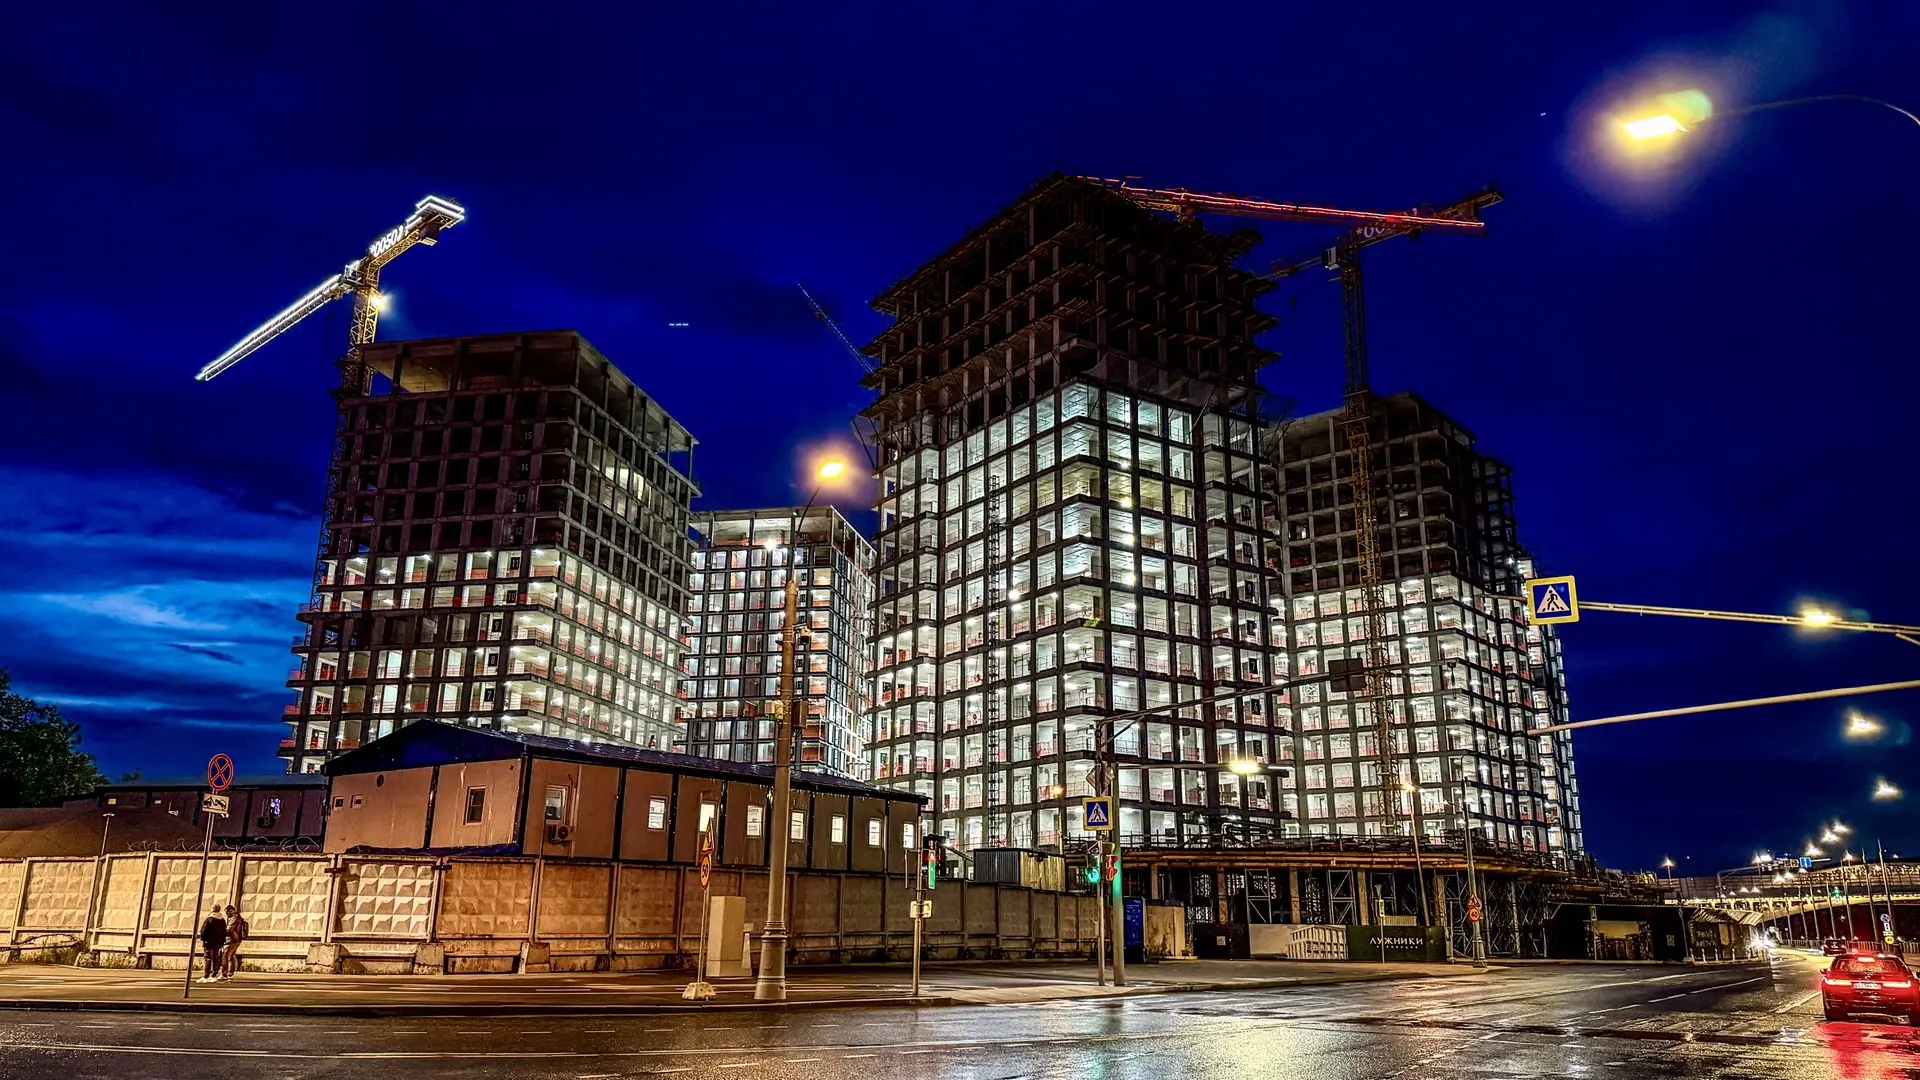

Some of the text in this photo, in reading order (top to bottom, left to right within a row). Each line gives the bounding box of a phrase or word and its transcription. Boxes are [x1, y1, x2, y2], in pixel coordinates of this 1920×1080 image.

[525, 432, 532, 440] 15
[516, 527, 523, 535] 12
[508, 593, 516, 601] 10
[1370, 937, 1423, 945] ЛУЖНИКИ
